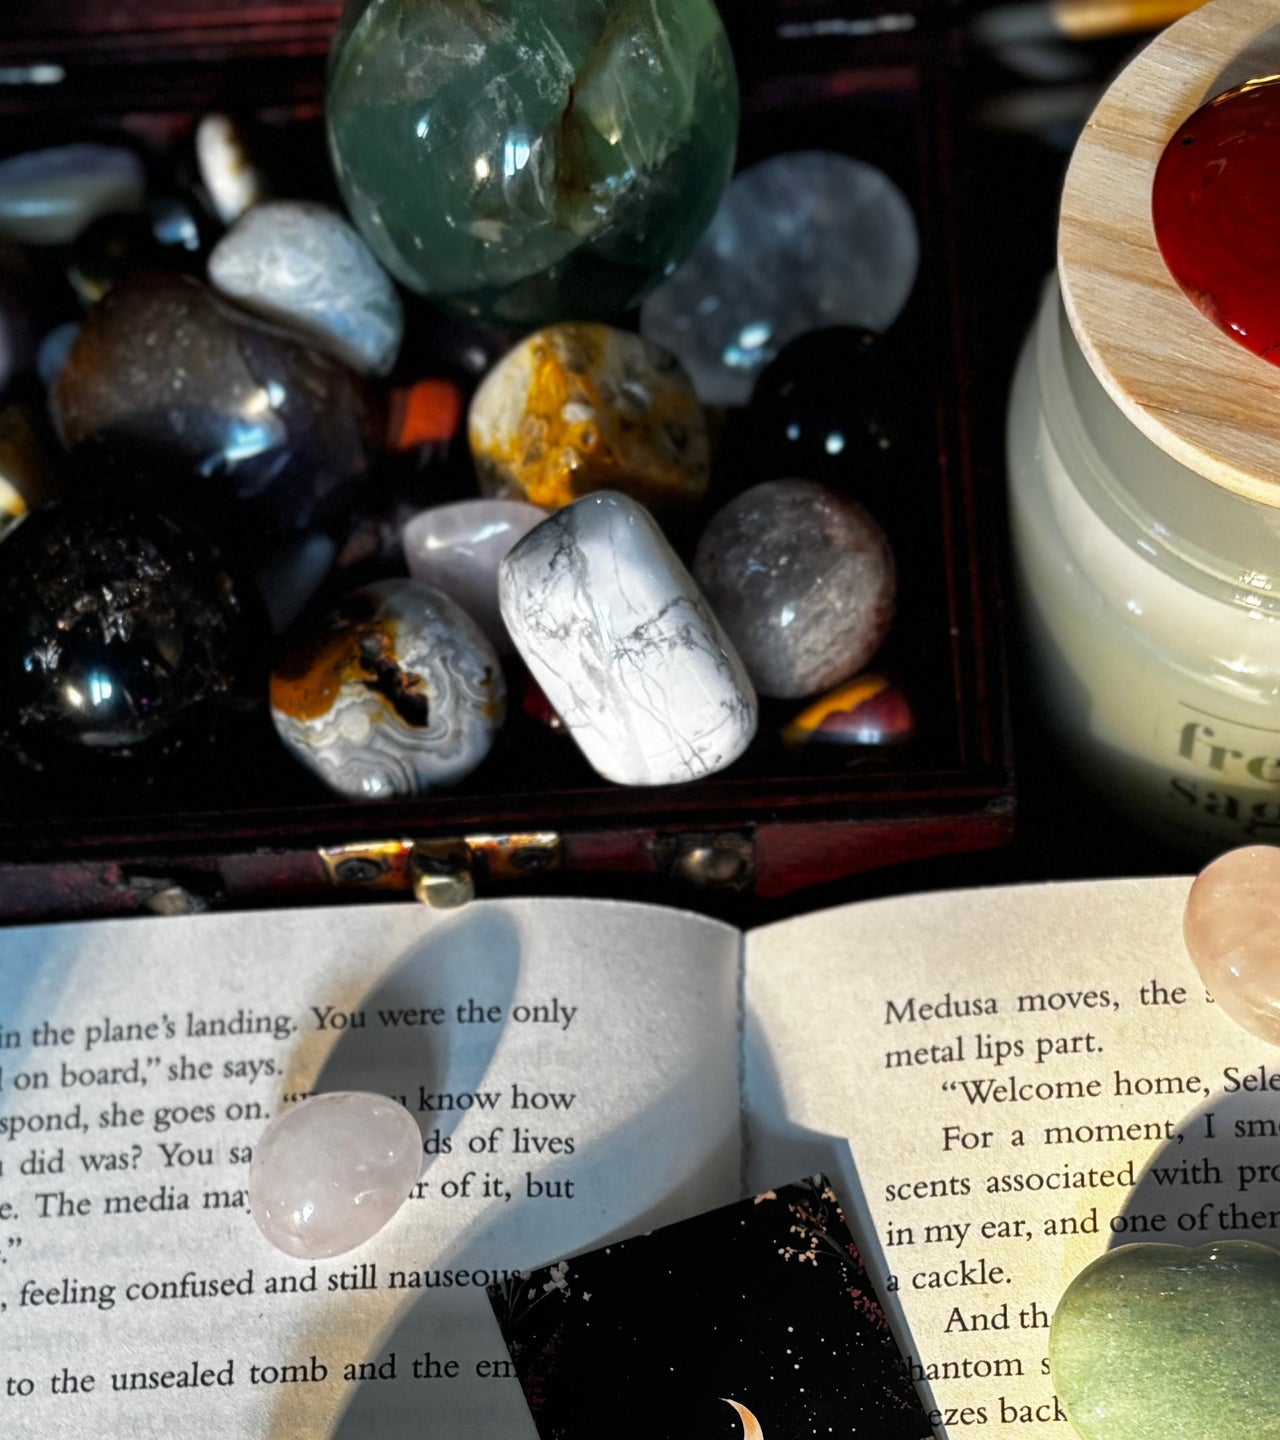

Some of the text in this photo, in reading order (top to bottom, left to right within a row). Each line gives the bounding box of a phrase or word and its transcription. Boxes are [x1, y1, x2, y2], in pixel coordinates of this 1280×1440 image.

[31, 1021, 75, 1047] the
[85, 1013, 176, 1052] plane’s
[186, 1009, 299, 1040] landing.
[311, 1005, 367, 1031] You
[377, 1007, 446, 1027] were
[456, 997, 502, 1024] the
[512, 996, 578, 1031] only
[885, 1033, 1104, 1069] metal lips part.
[98, 1101, 145, 1129] she
[153, 1104, 216, 1133] goes
[224, 1102, 271, 1121] on.
[417, 1085, 502, 1113] know
[510, 1083, 577, 1111] how
[941, 1075, 1102, 1106] “Welcome
[1113, 1069, 1211, 1098] home,
[885, 1176, 972, 1203] scents
[985, 1159, 1137, 1194] associated
[1149, 1156, 1224, 1187] with
[19, 1277, 117, 1311] feeling
[125, 1268, 255, 1302] confused
[263, 1265, 318, 1295] and
[327, 1262, 378, 1292] still
[885, 1257, 1012, 1293] a cackle.
